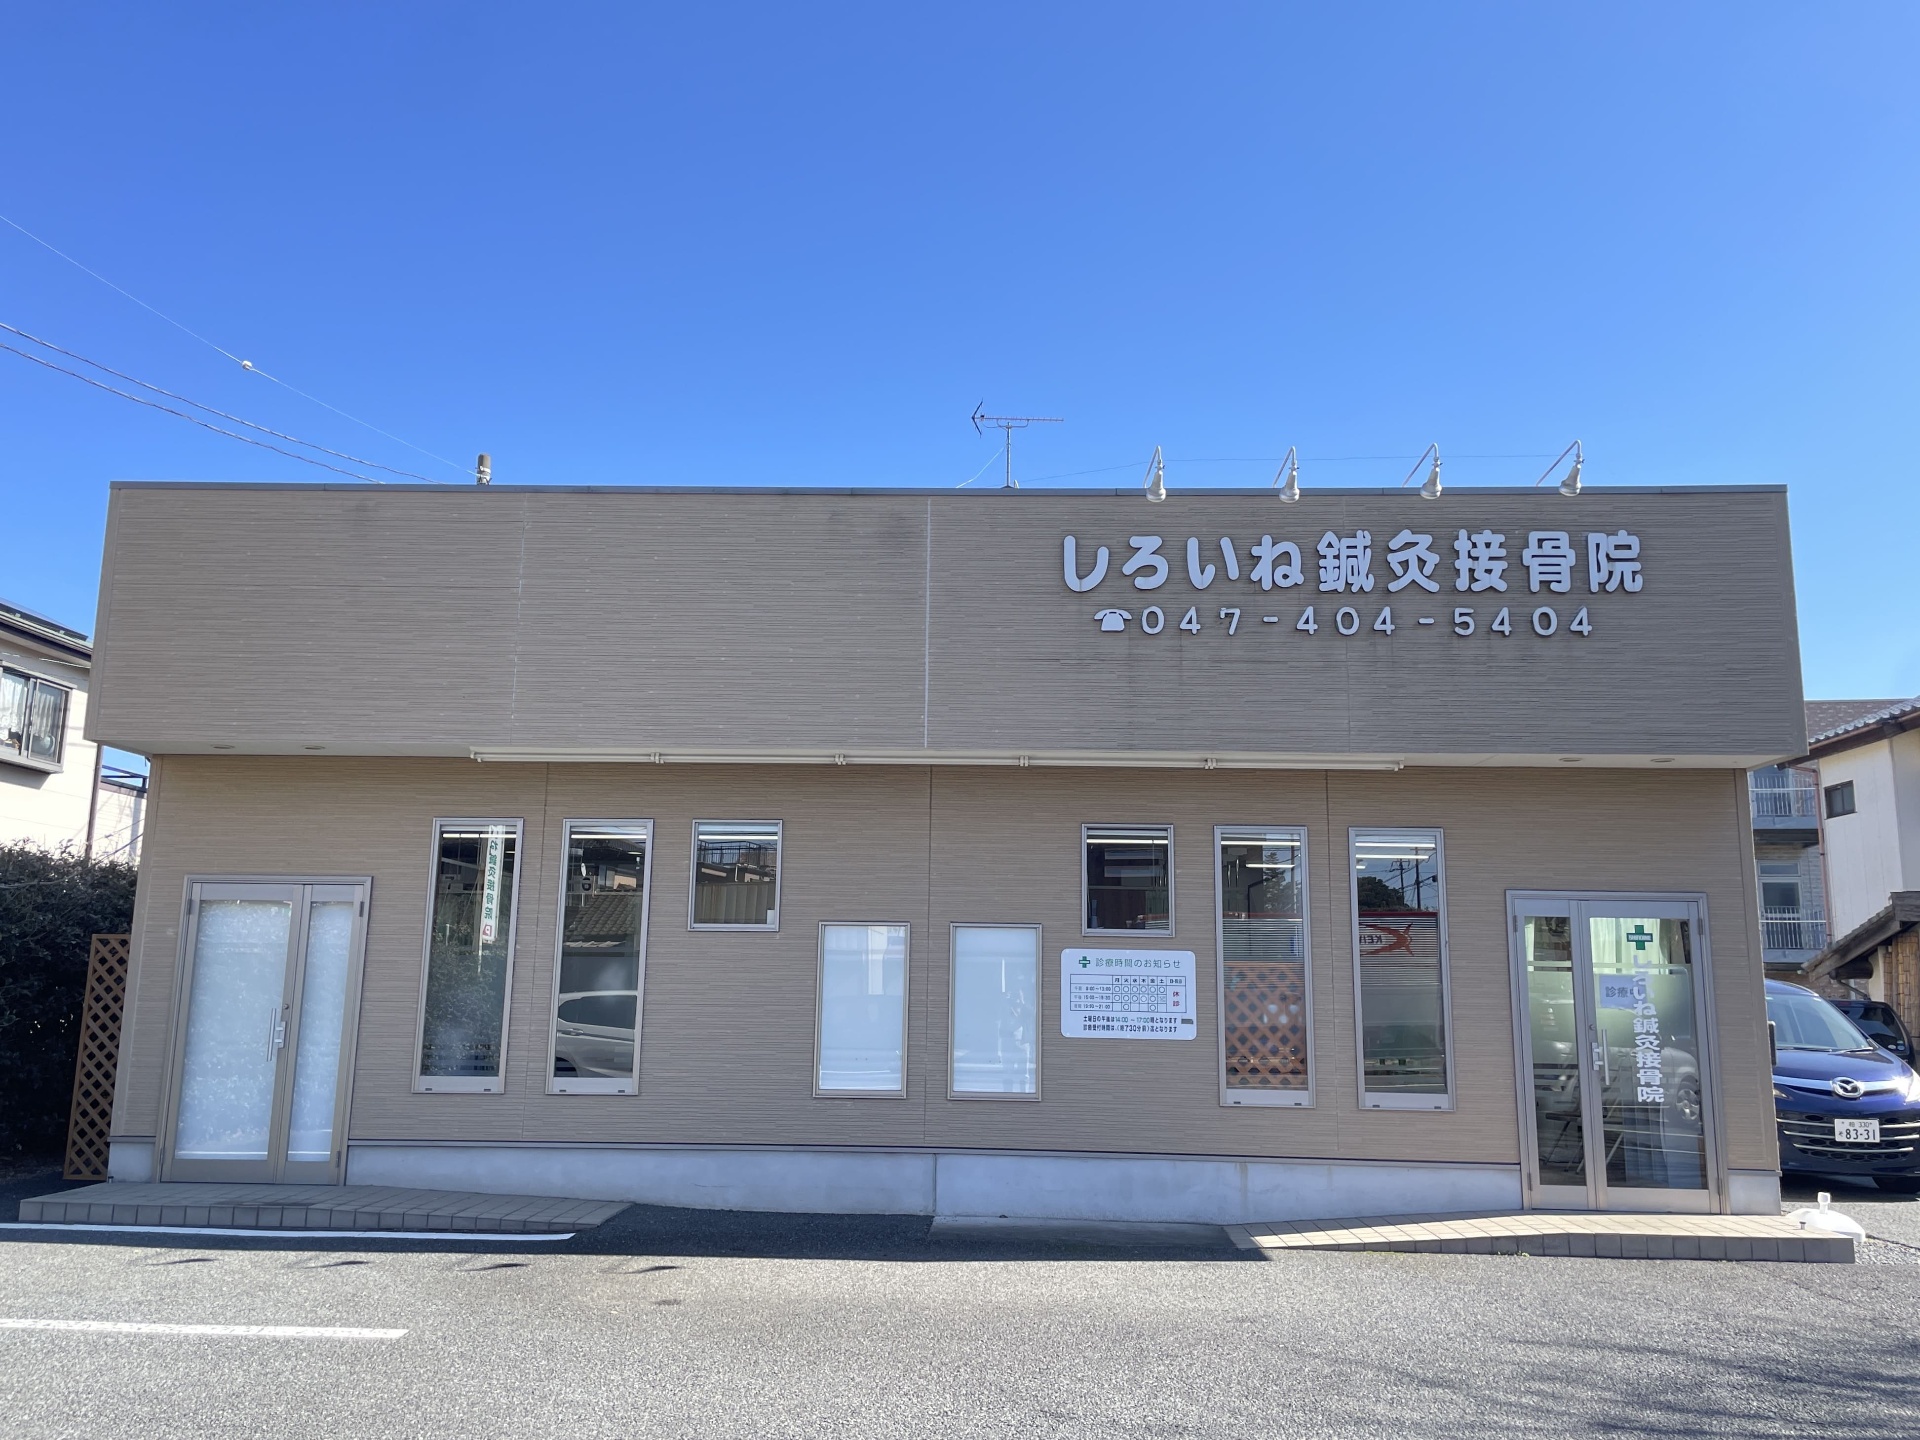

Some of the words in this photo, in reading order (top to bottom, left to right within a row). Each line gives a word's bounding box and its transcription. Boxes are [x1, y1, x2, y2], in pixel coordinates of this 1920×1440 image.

[1063, 529, 1643, 594] しろいね鍼灸接骨院
[1141, 605, 1594, 636] 047-404-5404
[1095, 957, 1181, 969] 診療時間のお知らせ
[1632, 954, 1665, 1103] しろいね鍼灸接骨院
[1845, 1128, 1876, 1140] 83-31
